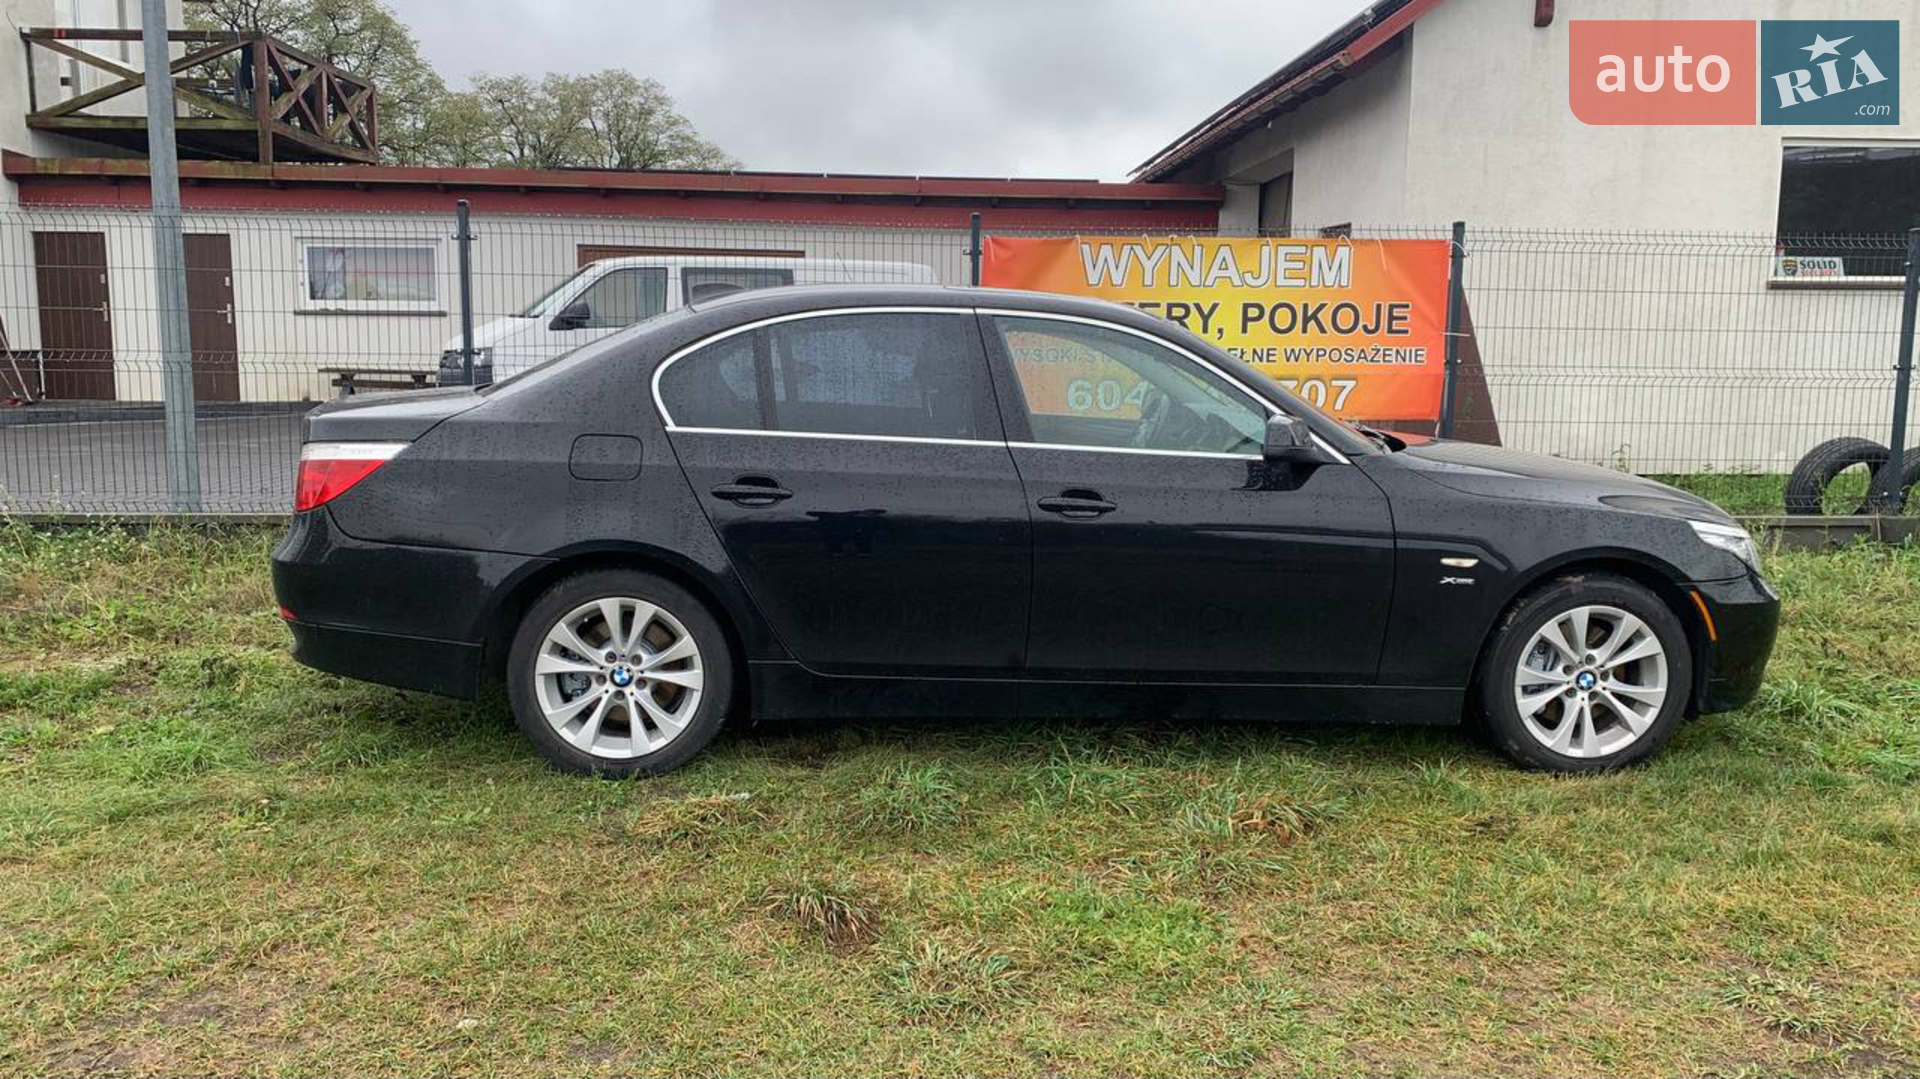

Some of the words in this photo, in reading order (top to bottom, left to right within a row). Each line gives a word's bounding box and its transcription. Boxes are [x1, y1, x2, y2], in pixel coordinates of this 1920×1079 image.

[1080, 243, 1352, 288] WYNAJEM
[1800, 260, 1837, 270] SOLID
[1240, 302, 1411, 336] POKOJE
[1283, 345, 1426, 364] WYPOSAŻENIE
